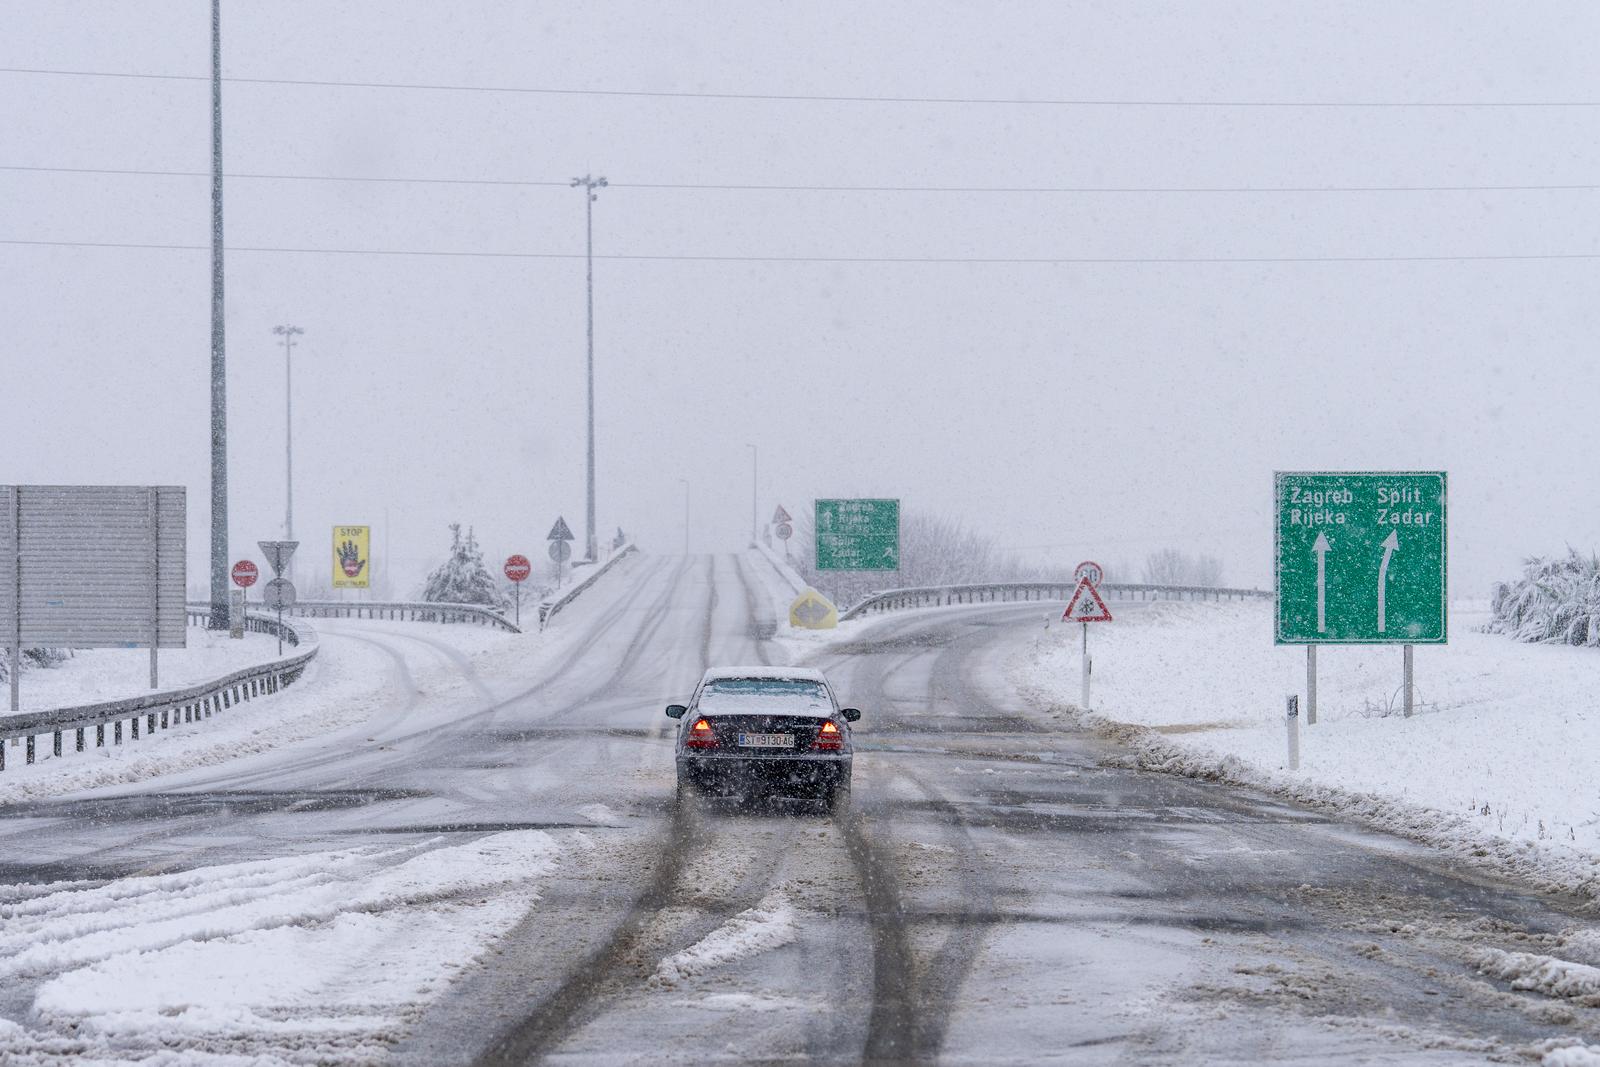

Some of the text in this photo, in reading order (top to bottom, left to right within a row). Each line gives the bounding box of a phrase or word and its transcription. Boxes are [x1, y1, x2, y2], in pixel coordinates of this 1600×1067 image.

[1290, 486, 1353, 507] Zagreb
[1377, 486, 1421, 507] Split
[1290, 508, 1346, 528] Rijeka
[1377, 508, 1432, 525] Zadar
[340, 528, 362, 536] STOP
